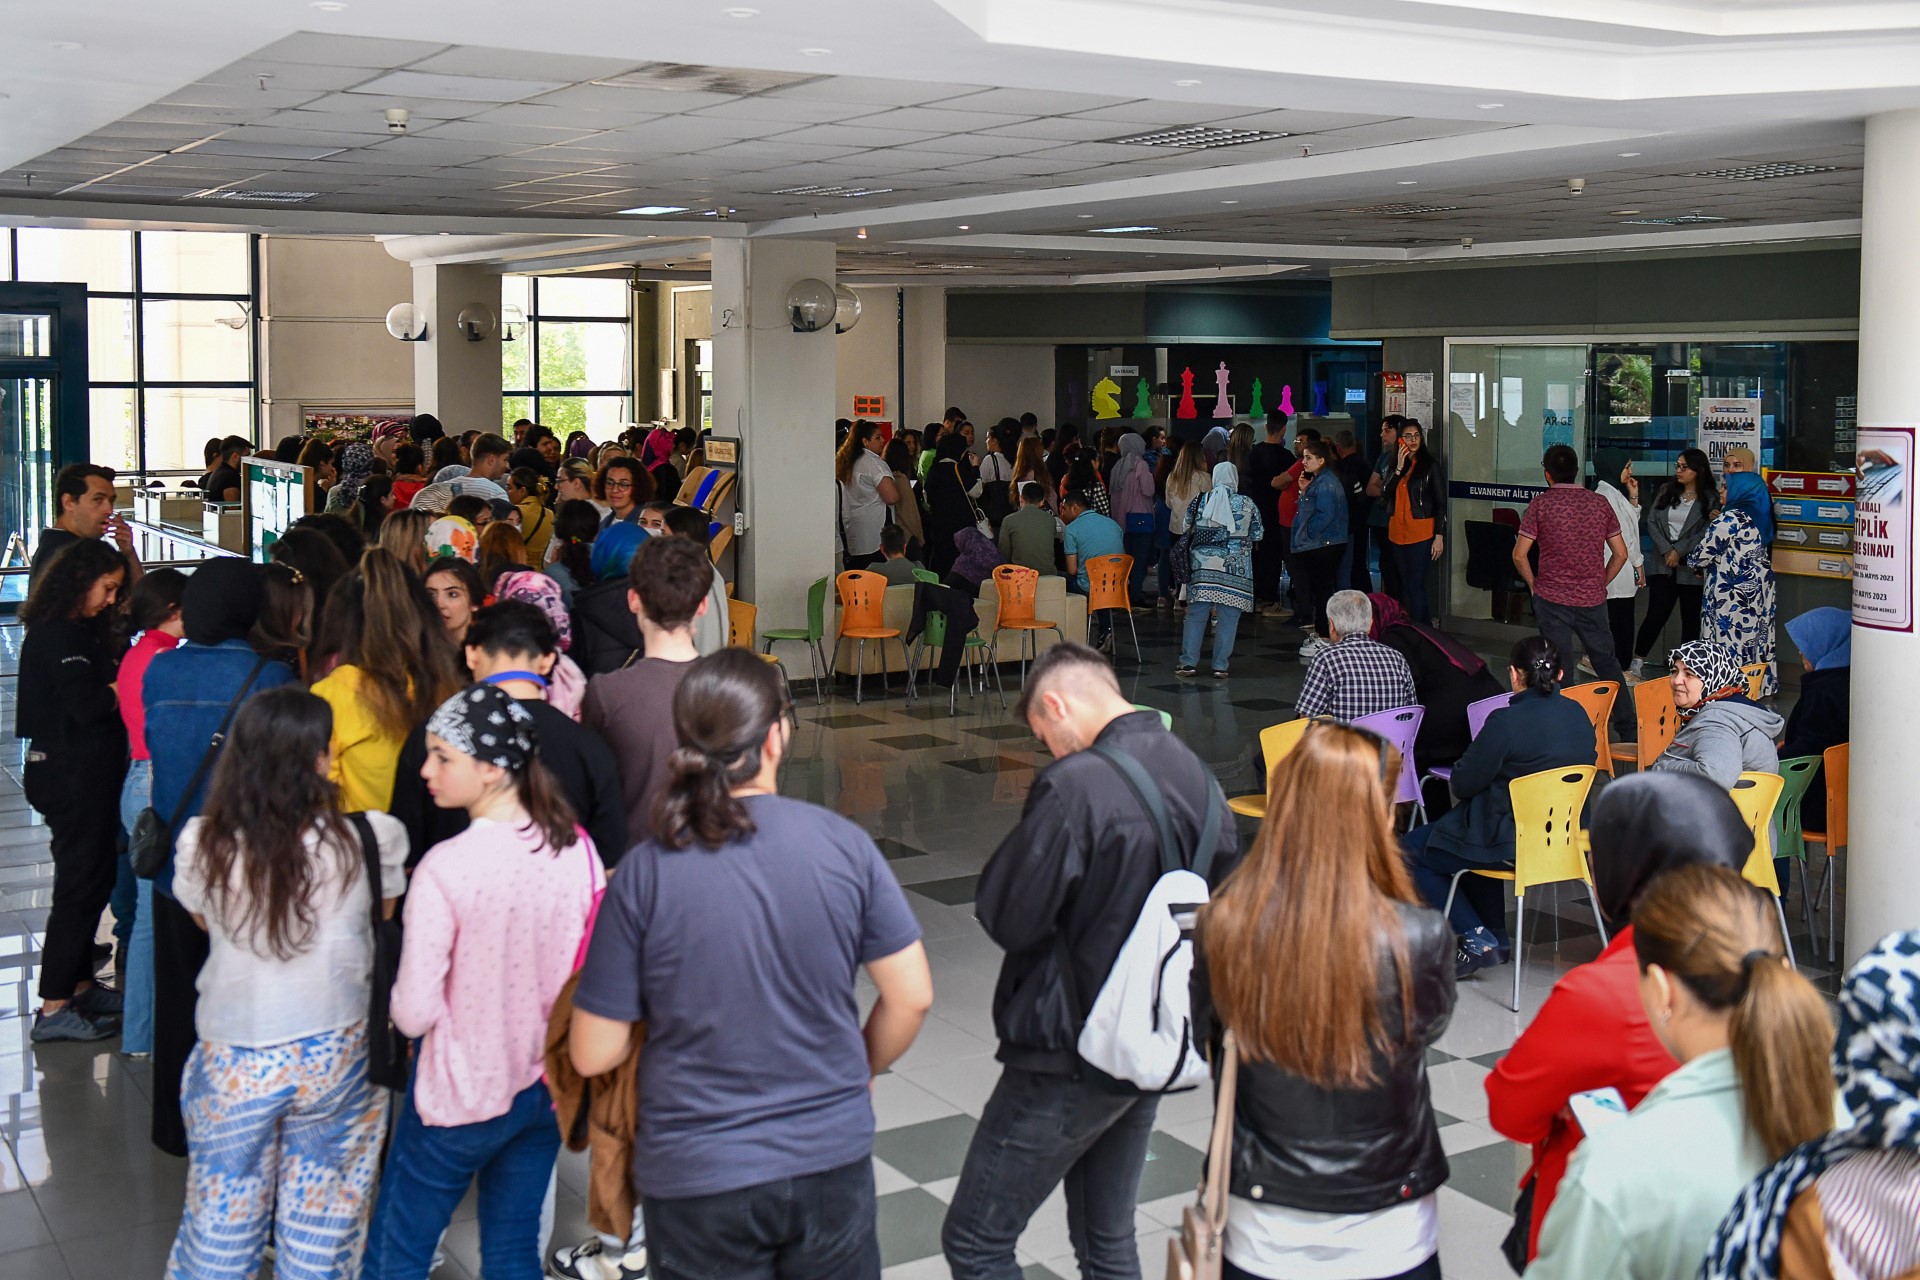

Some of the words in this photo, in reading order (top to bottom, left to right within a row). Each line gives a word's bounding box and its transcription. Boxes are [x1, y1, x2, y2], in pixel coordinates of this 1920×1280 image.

[1469, 486, 1511, 497] ELVANKENT
[1512, 488, 1529, 498] AİLE
[1862, 542, 1894, 558] SINAVI
[1873, 592, 1887, 600] 2023
